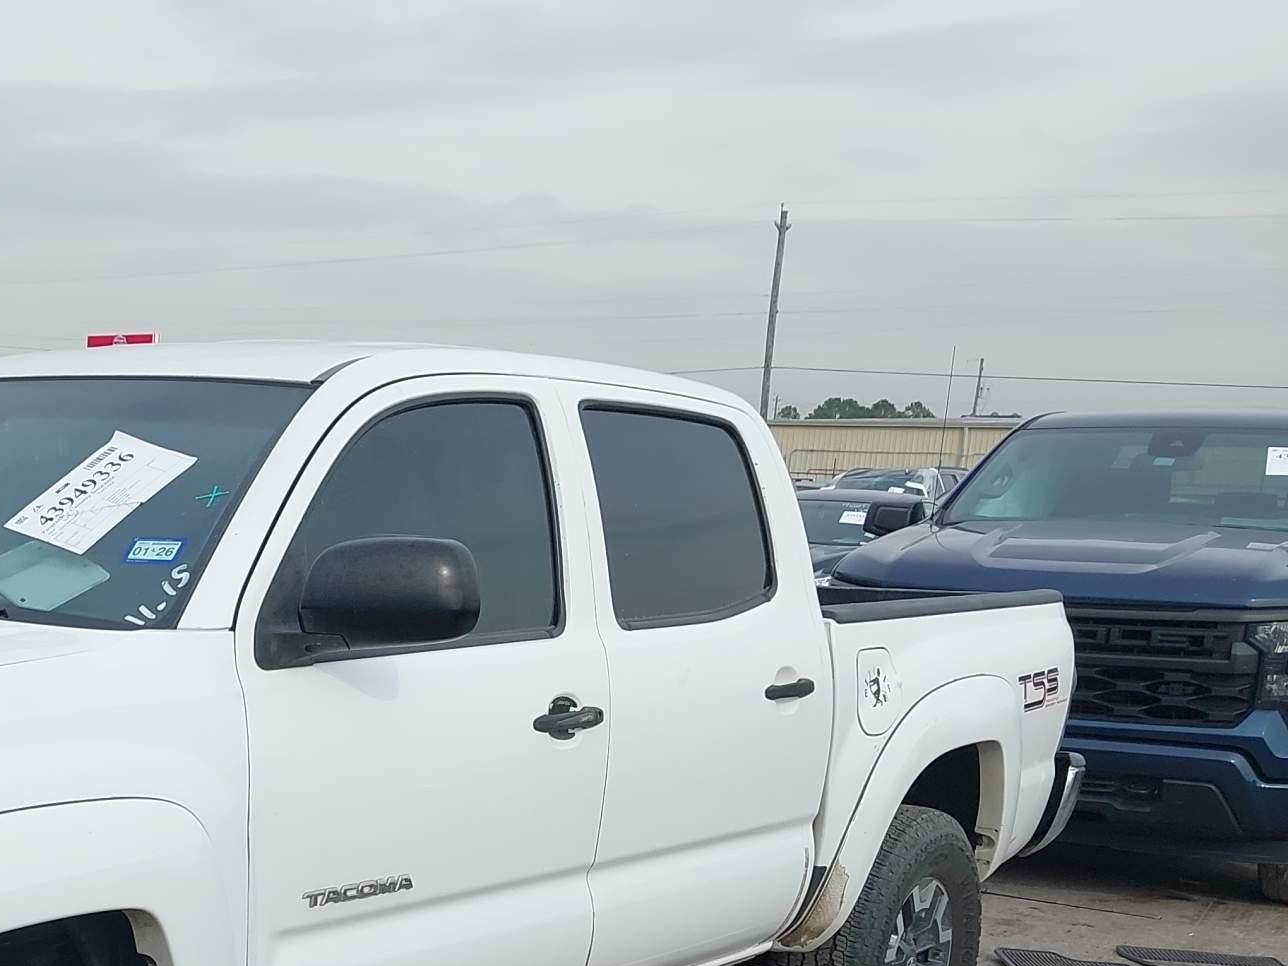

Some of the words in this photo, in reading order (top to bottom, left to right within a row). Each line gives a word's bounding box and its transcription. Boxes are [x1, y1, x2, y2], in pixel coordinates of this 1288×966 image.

[40, 451, 134, 525] 43949336
[1018, 667, 1059, 713] TSS
[301, 873, 414, 908] TACOMA
